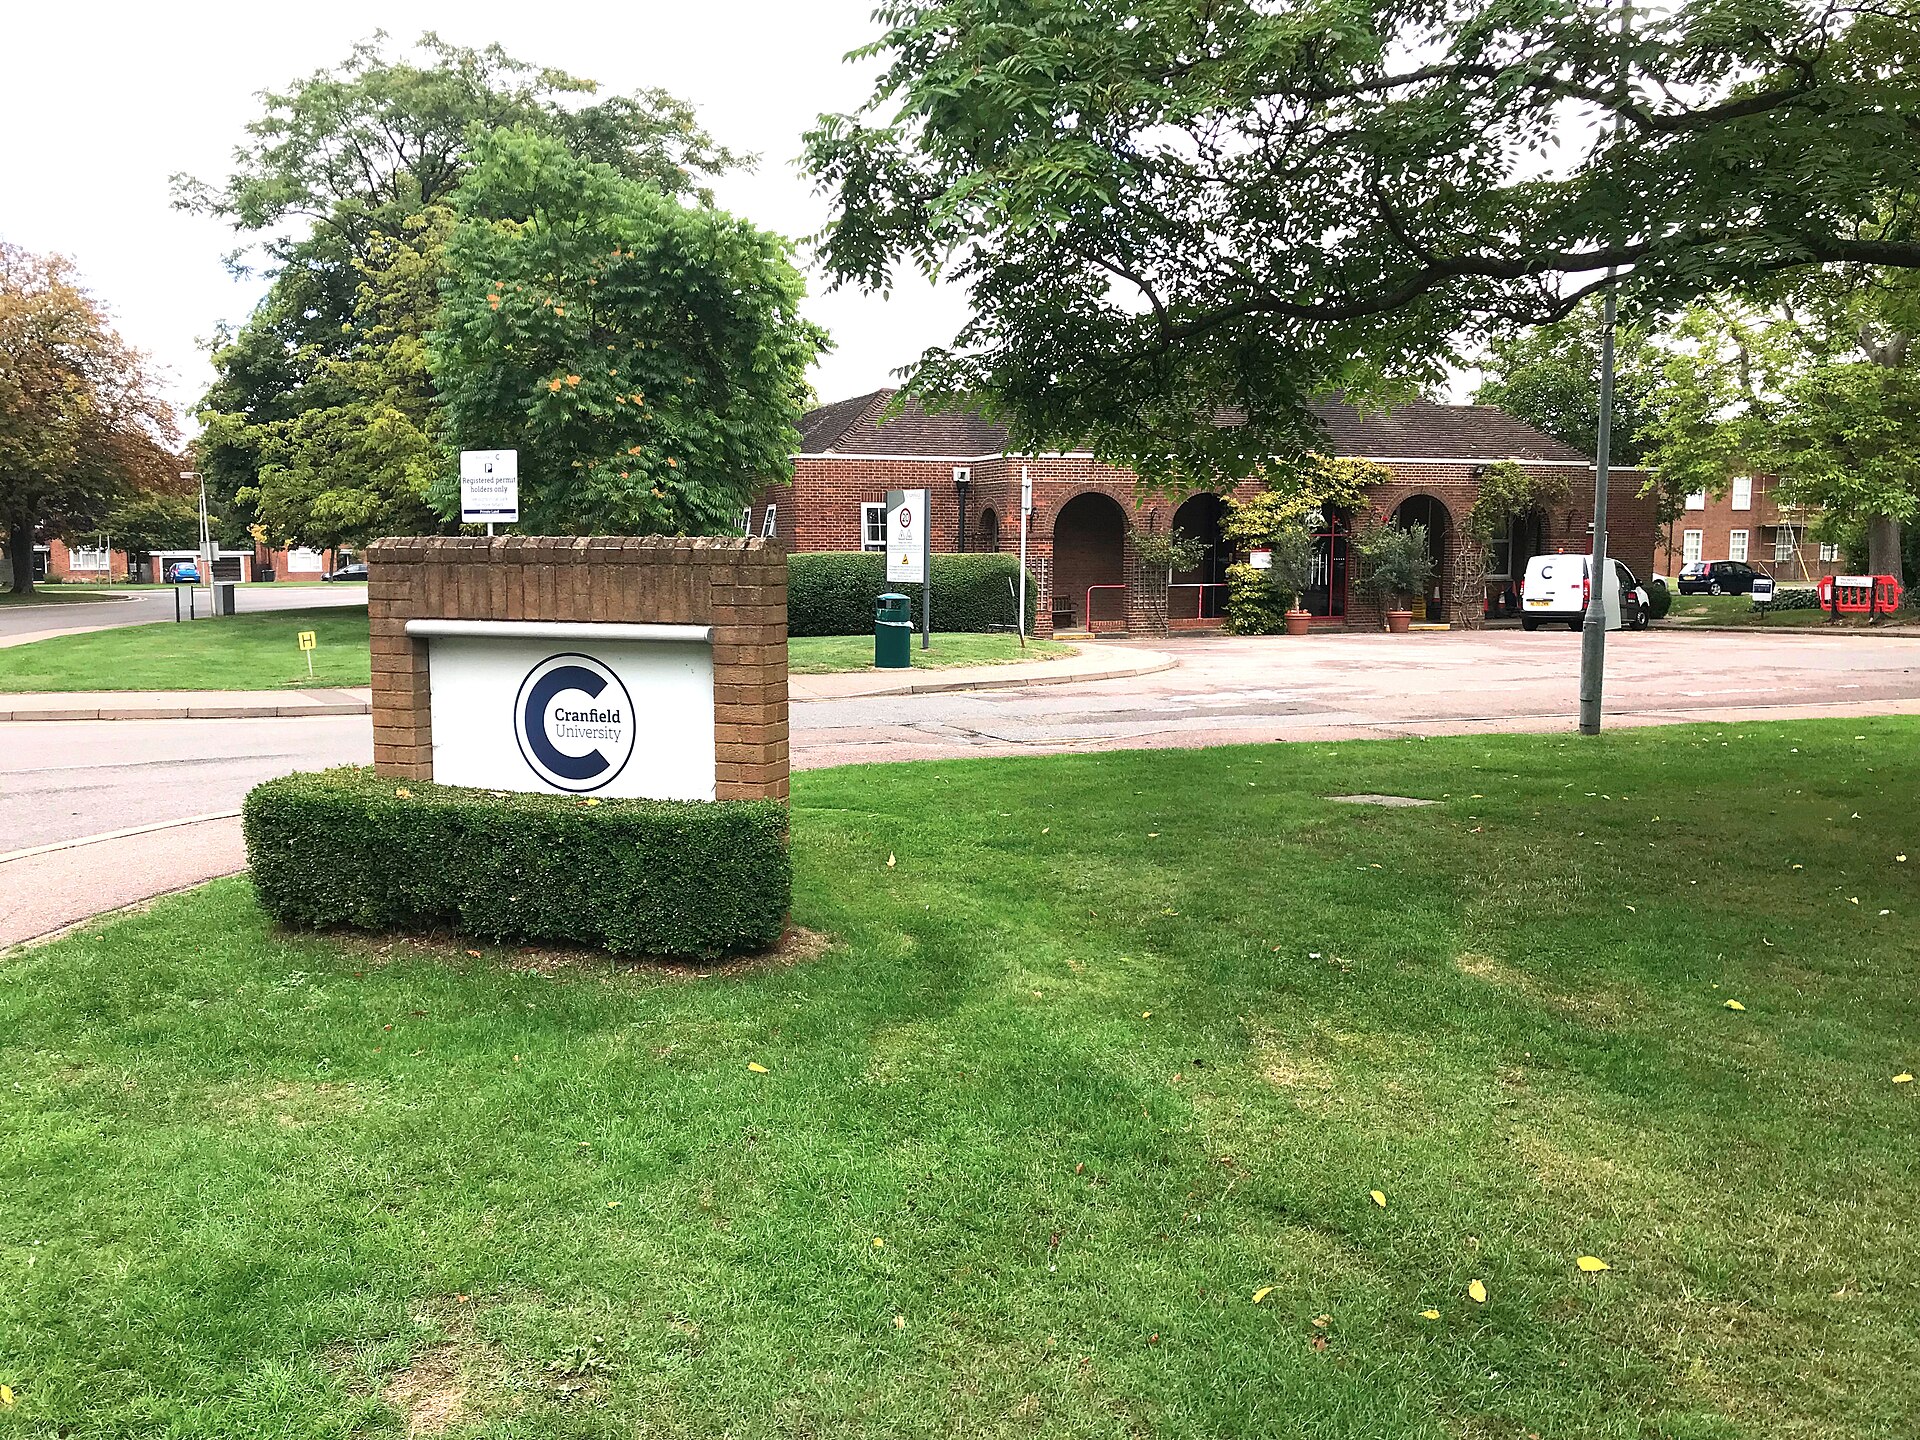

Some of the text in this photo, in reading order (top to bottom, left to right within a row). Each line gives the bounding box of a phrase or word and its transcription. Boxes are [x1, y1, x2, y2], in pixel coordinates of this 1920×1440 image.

[462, 476, 516, 485] Registered permit
[494, 485, 508, 494] only
[301, 633, 313, 648] H
[554, 707, 621, 724] Cranfield
[556, 723, 622, 743] University
